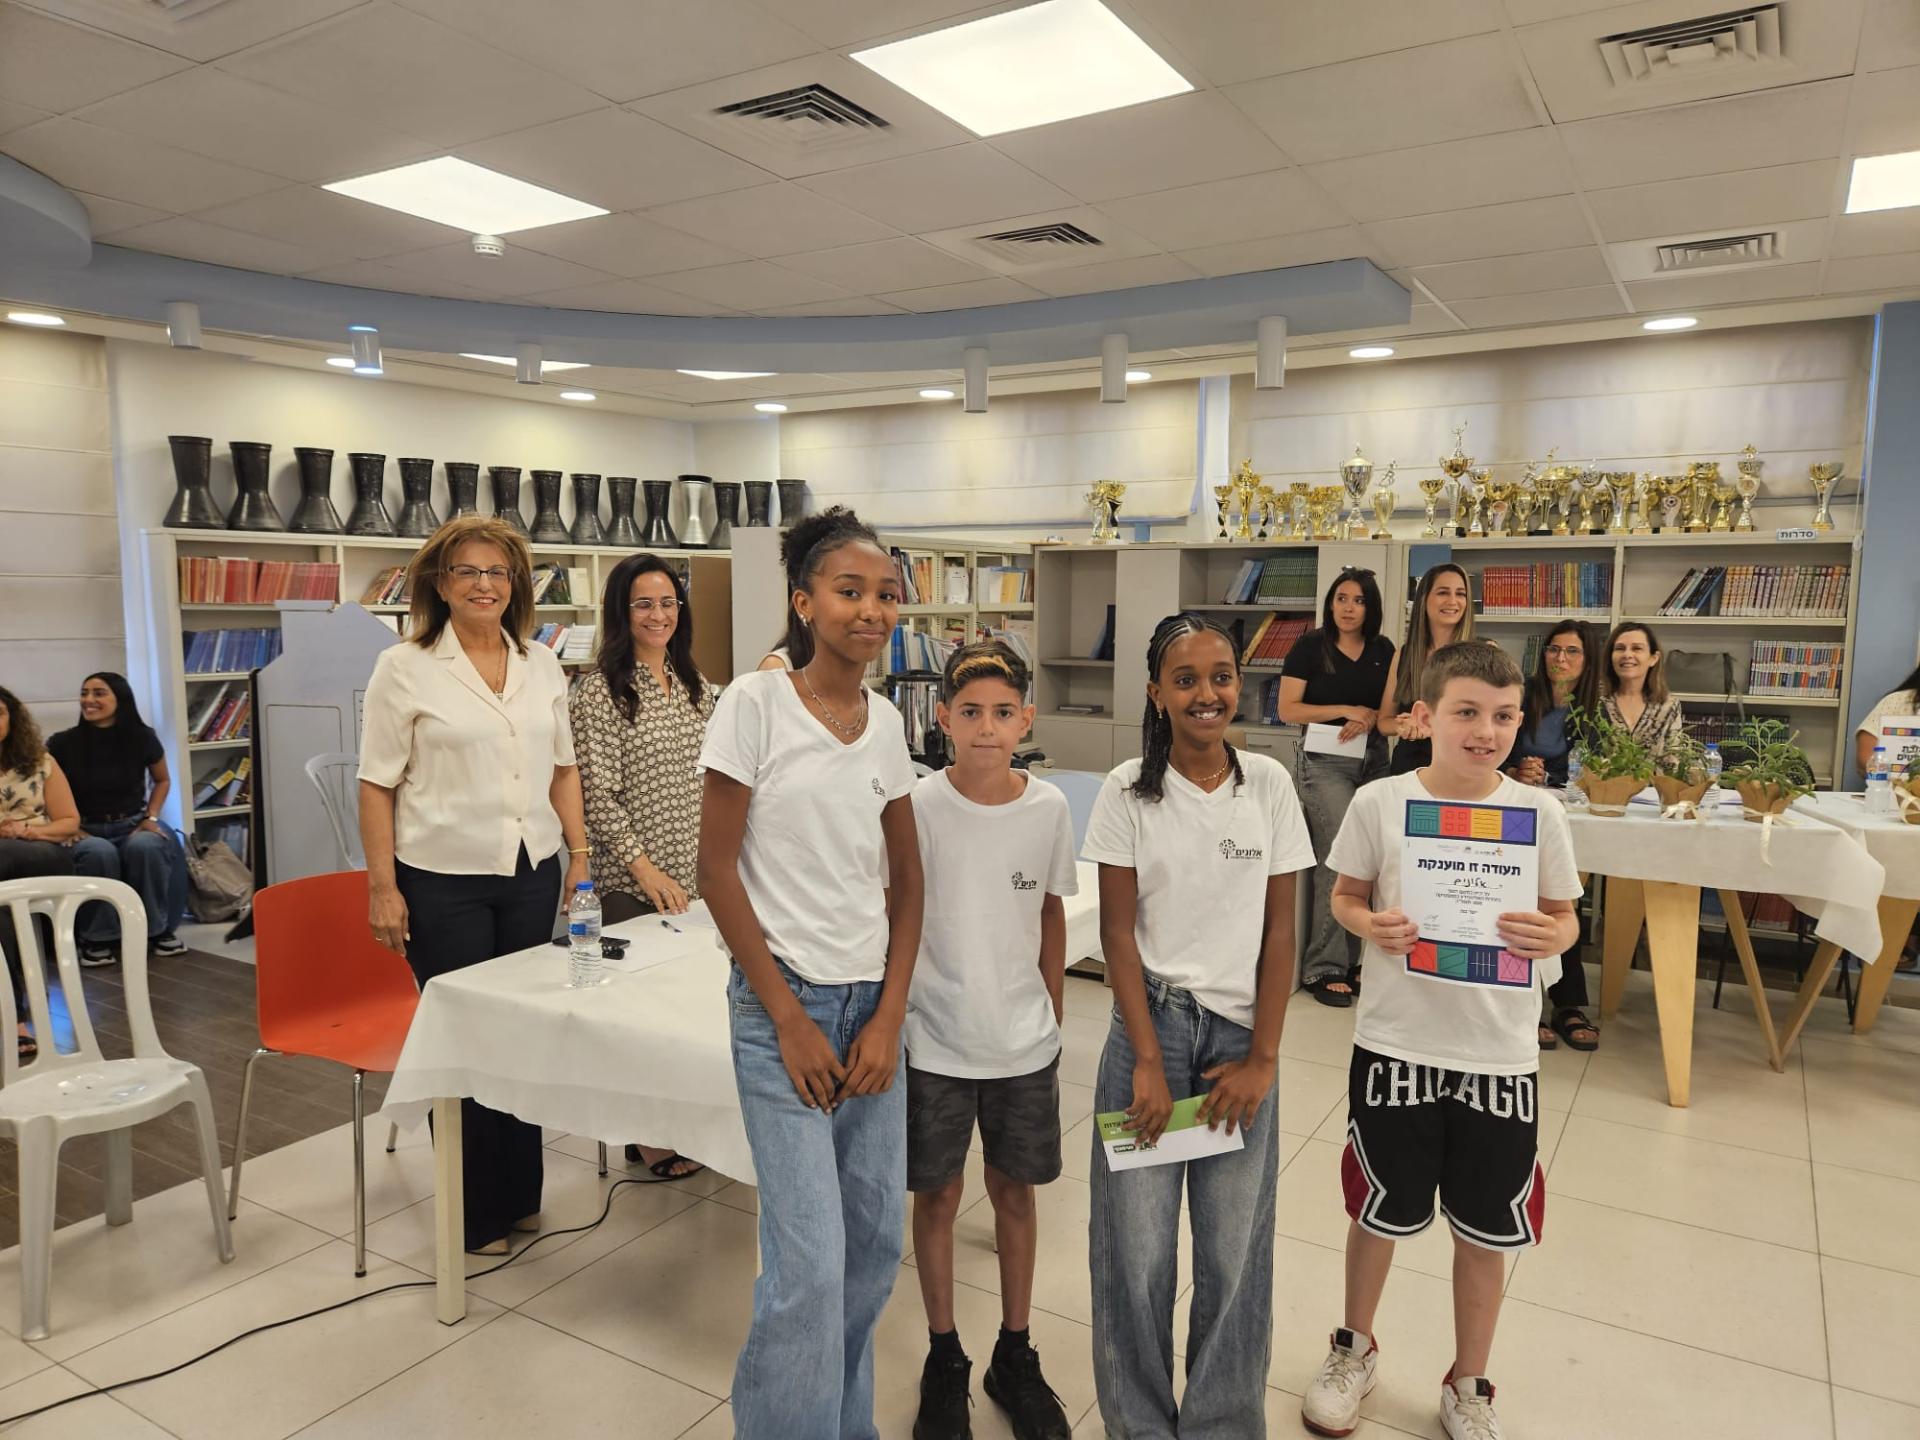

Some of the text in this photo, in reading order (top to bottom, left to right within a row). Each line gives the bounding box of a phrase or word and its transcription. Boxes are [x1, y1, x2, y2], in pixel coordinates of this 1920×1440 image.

[1780, 531, 1814, 539] סדרות
[1235, 848, 1263, 857] אלונים
[1417, 858, 1521, 876] תעודה זו מוענקת
